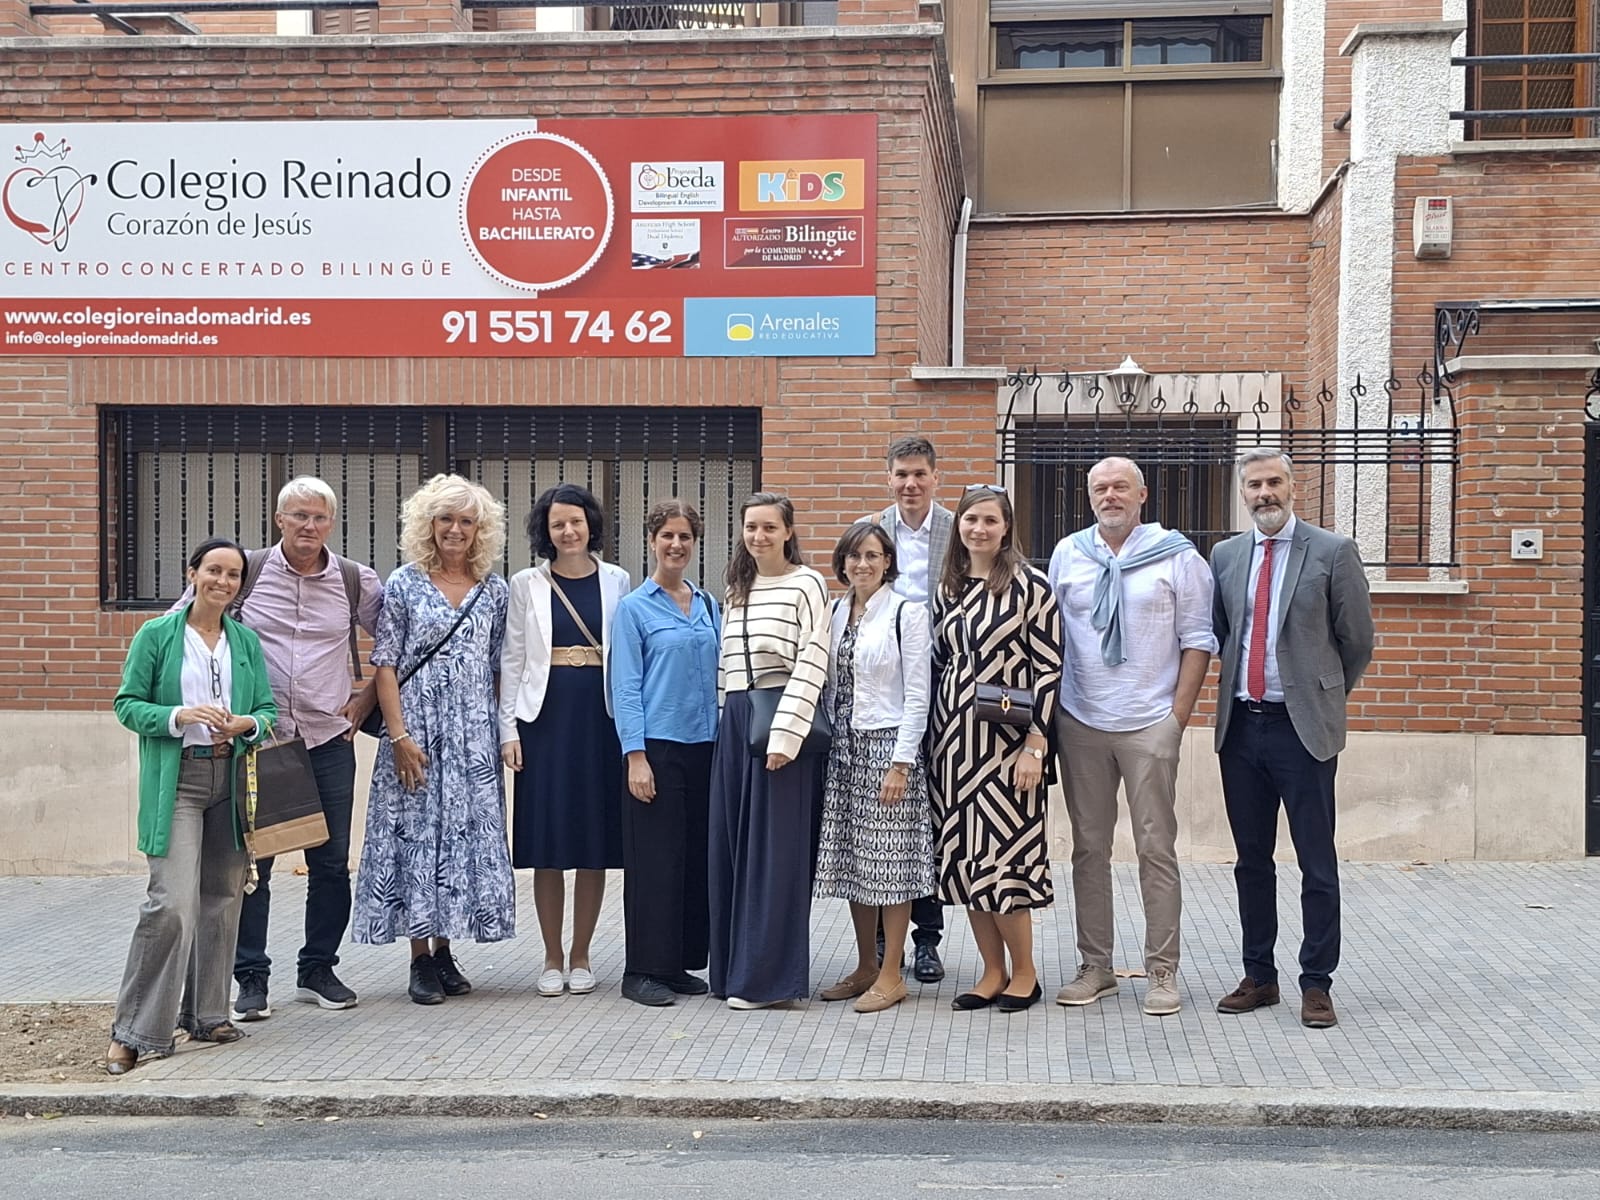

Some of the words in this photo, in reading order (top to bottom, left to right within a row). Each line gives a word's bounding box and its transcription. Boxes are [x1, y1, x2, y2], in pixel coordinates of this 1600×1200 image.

[511, 168, 562, 182] DESDE
[666, 166, 716, 188] beda
[107, 158, 267, 211] Colegio
[283, 157, 451, 199] Reinado
[501, 187, 573, 202] INFANTIL
[655, 192, 679, 200] Bilingual
[680, 192, 700, 200] English
[638, 199, 676, 207] Development
[512, 206, 562, 221] HASTA
[107, 212, 209, 236] Corazón
[217, 212, 246, 236] de
[252, 212, 312, 239] Jesús
[761, 227, 782, 235] Centro
[479, 226, 595, 241] BACHILLERATO
[731, 234, 781, 242] AUTORIZADO
[785, 224, 857, 248] Bilingüe
[743, 247, 755, 256] por
[755, 246, 761, 254] la
[762, 254, 773, 262] DE
[4, 261, 110, 276] CENTRO
[121, 261, 305, 276] CONCERTADO
[322, 258, 453, 277] BILINGÜE
[4, 307, 312, 330] www.colegioreinadomadrid.es
[759, 311, 840, 331] Arenales
[442, 310, 478, 344] 91
[489, 309, 553, 344] 551
[564, 309, 614, 344] 74
[624, 309, 672, 344] 62
[5, 330, 219, 347] info@colegioreinadomadrid.es
[781, 332, 840, 340] EDUCATIVA
